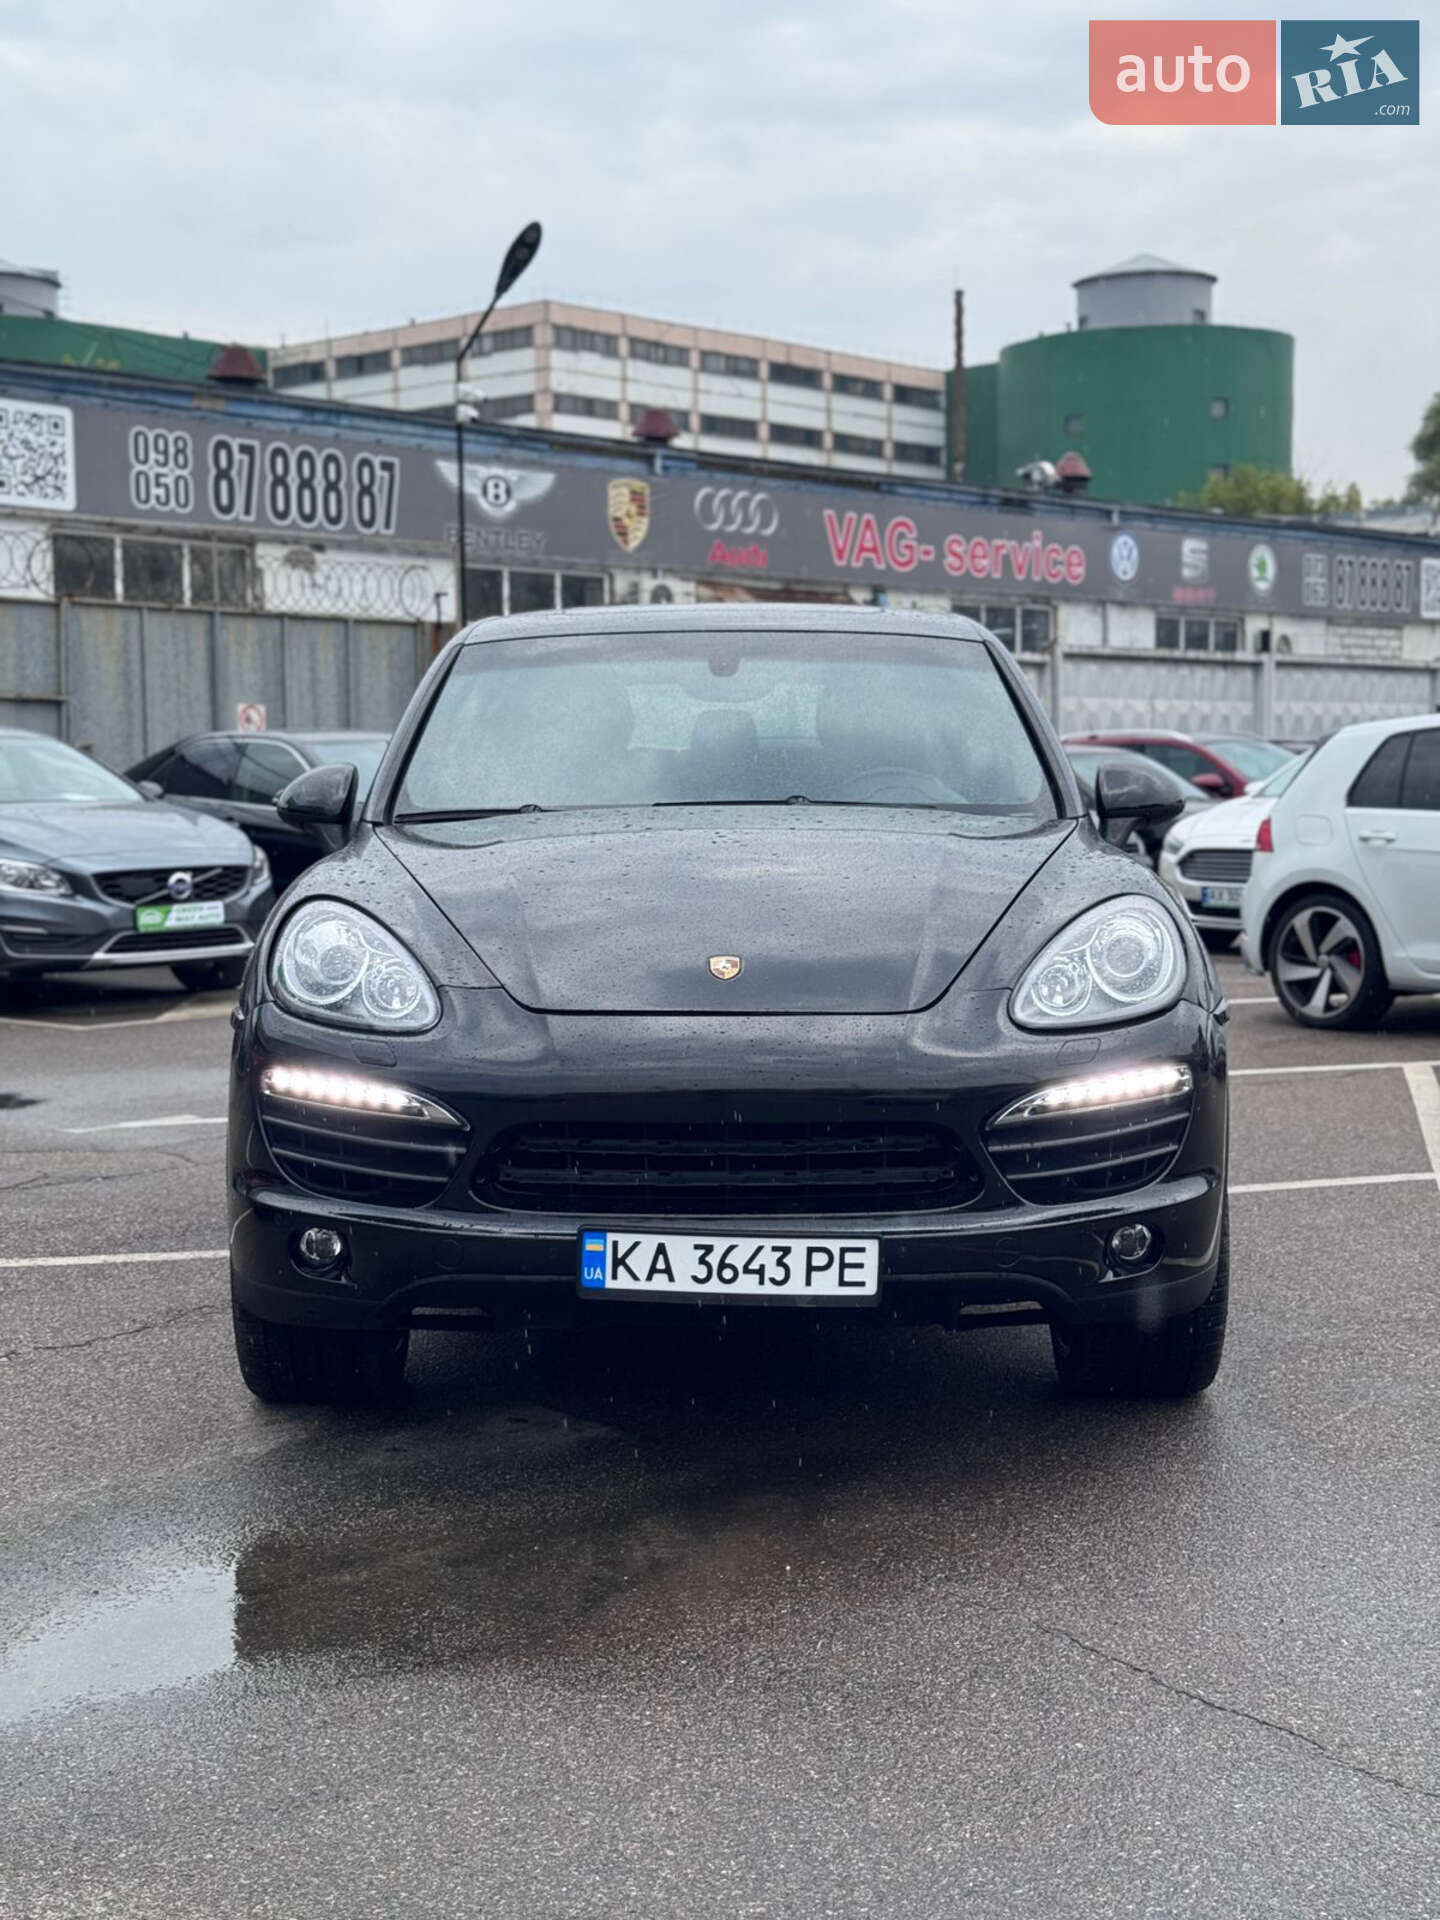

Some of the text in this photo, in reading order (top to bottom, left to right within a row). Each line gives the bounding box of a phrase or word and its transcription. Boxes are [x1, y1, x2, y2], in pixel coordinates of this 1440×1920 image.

[132, 426, 192, 470] 098
[133, 470, 194, 513] 050
[210, 435, 399, 534] 87 888 87
[943, 530, 1087, 585] service
[584, 1267, 603, 1280] UA
[611, 1240, 866, 1287] KA 3643 PE
